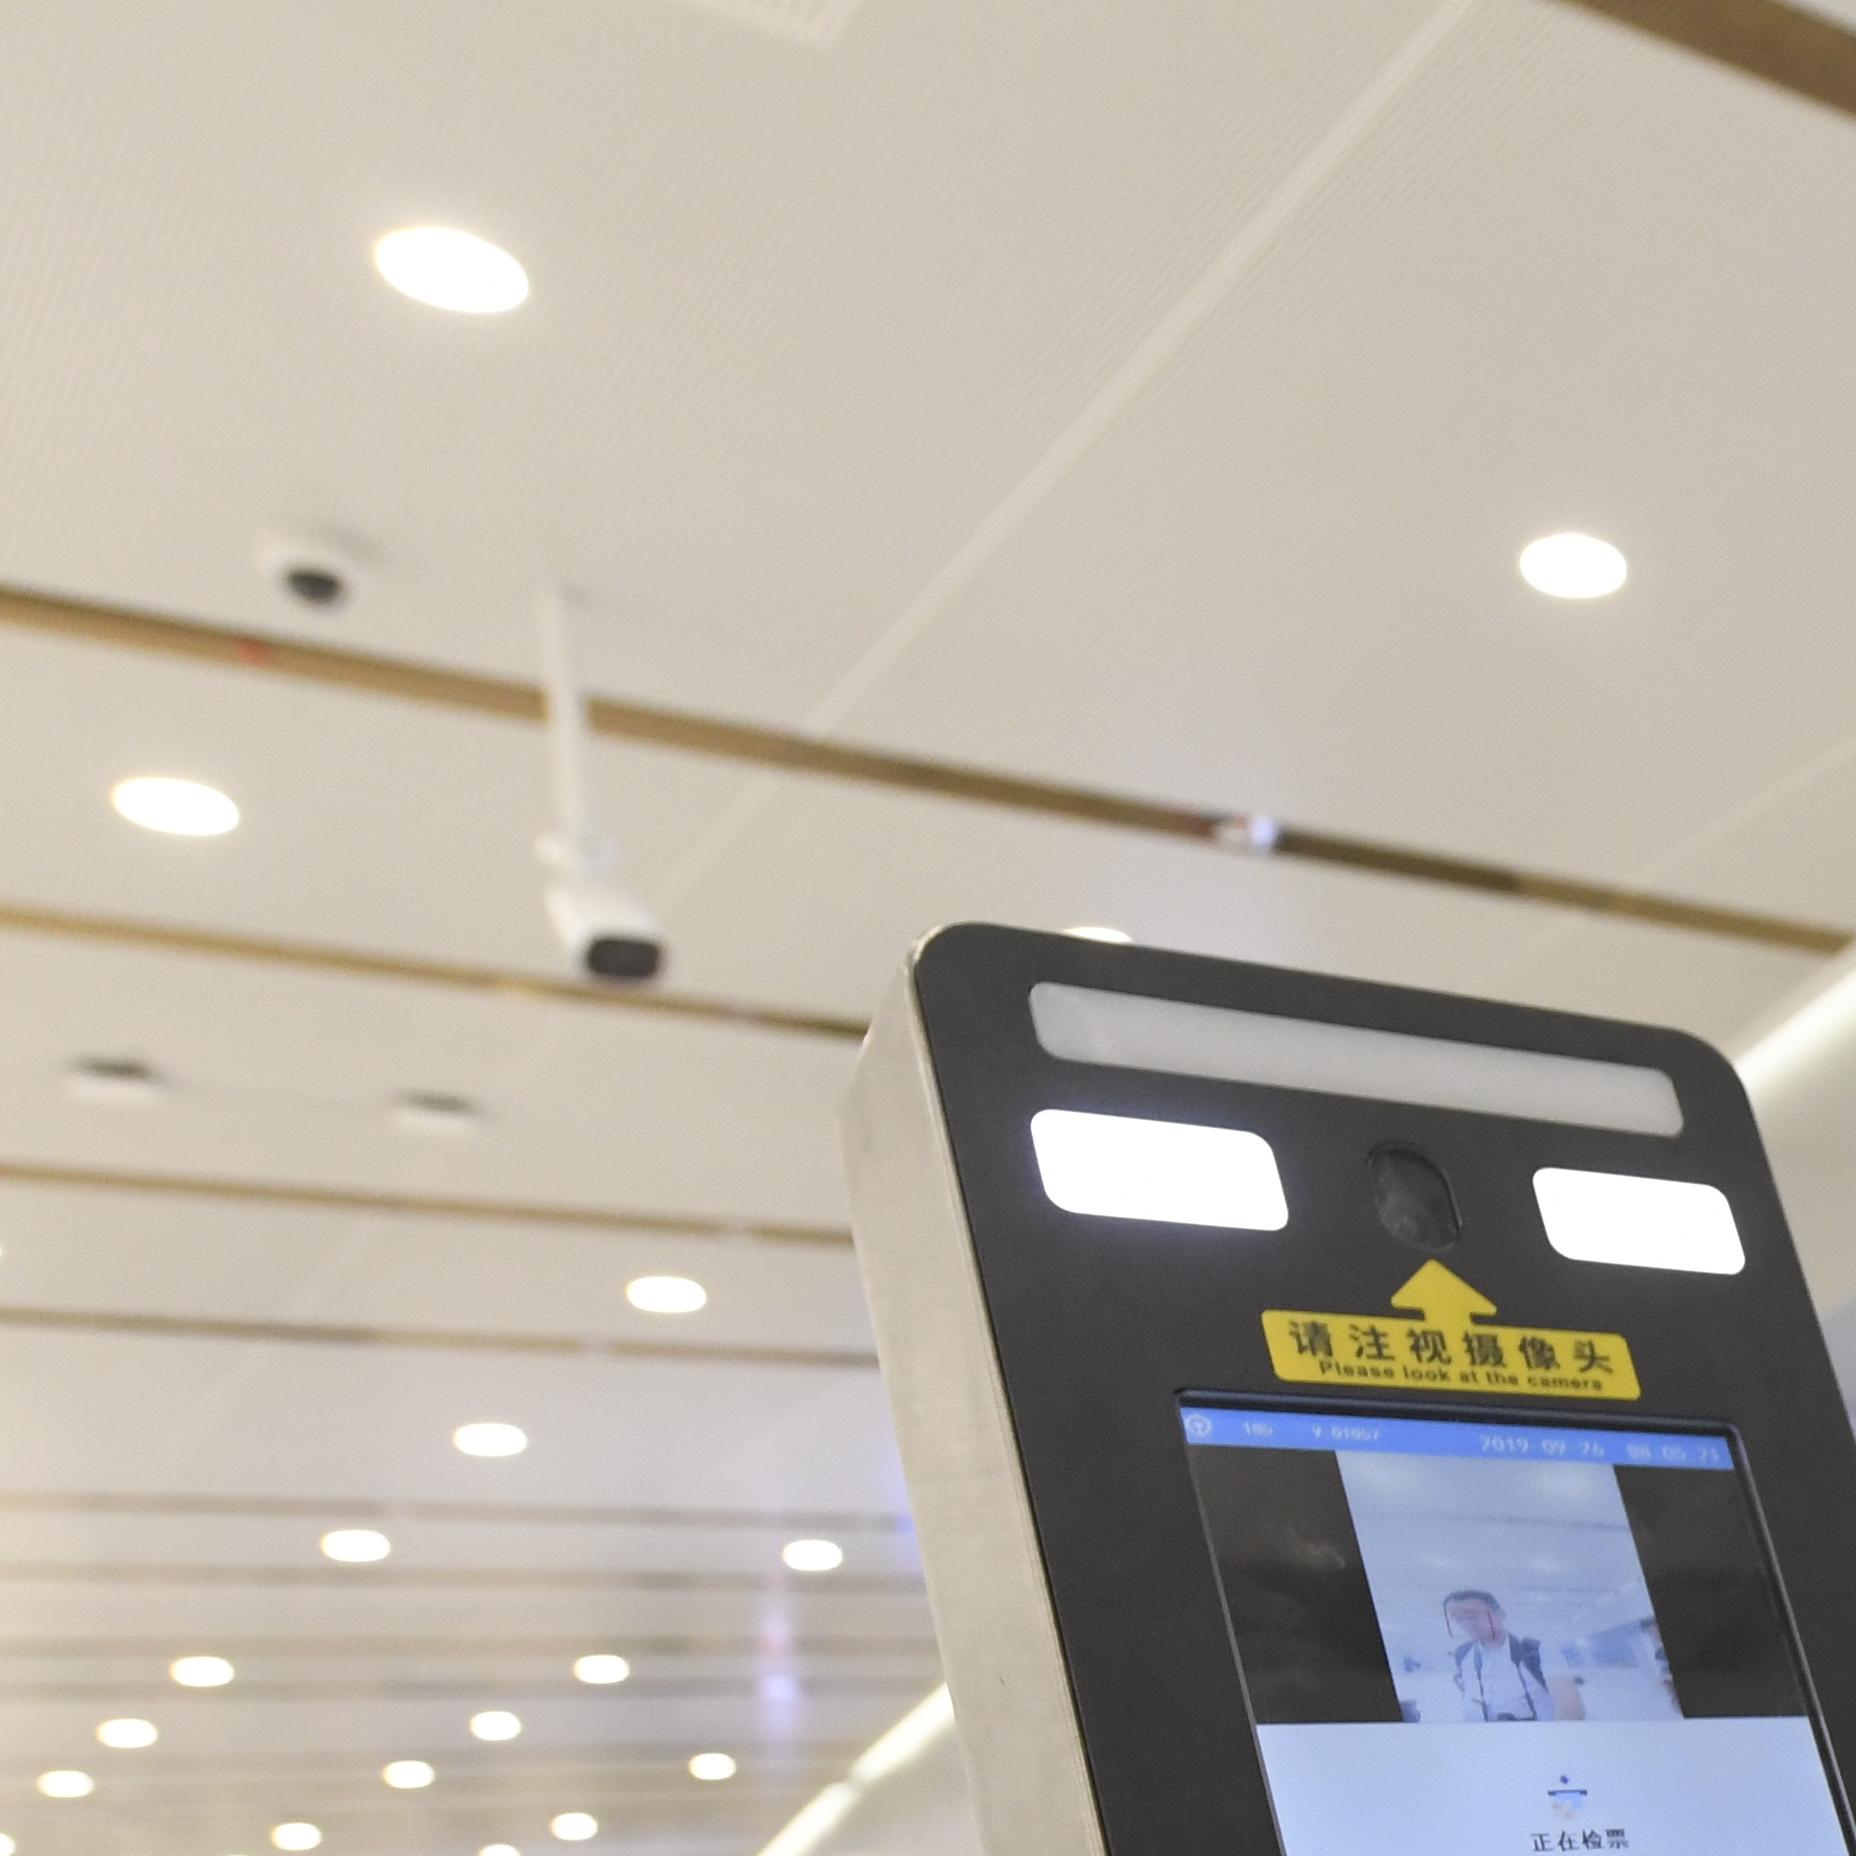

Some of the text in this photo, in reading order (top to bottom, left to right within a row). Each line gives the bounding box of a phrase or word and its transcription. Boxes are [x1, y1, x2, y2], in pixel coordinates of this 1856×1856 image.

[1289, 1320, 1614, 1374] 请注视摄像头
[1319, 1361, 1603, 1391] Please look at the camera
[1530, 1828, 1630, 1852] 正在检票
